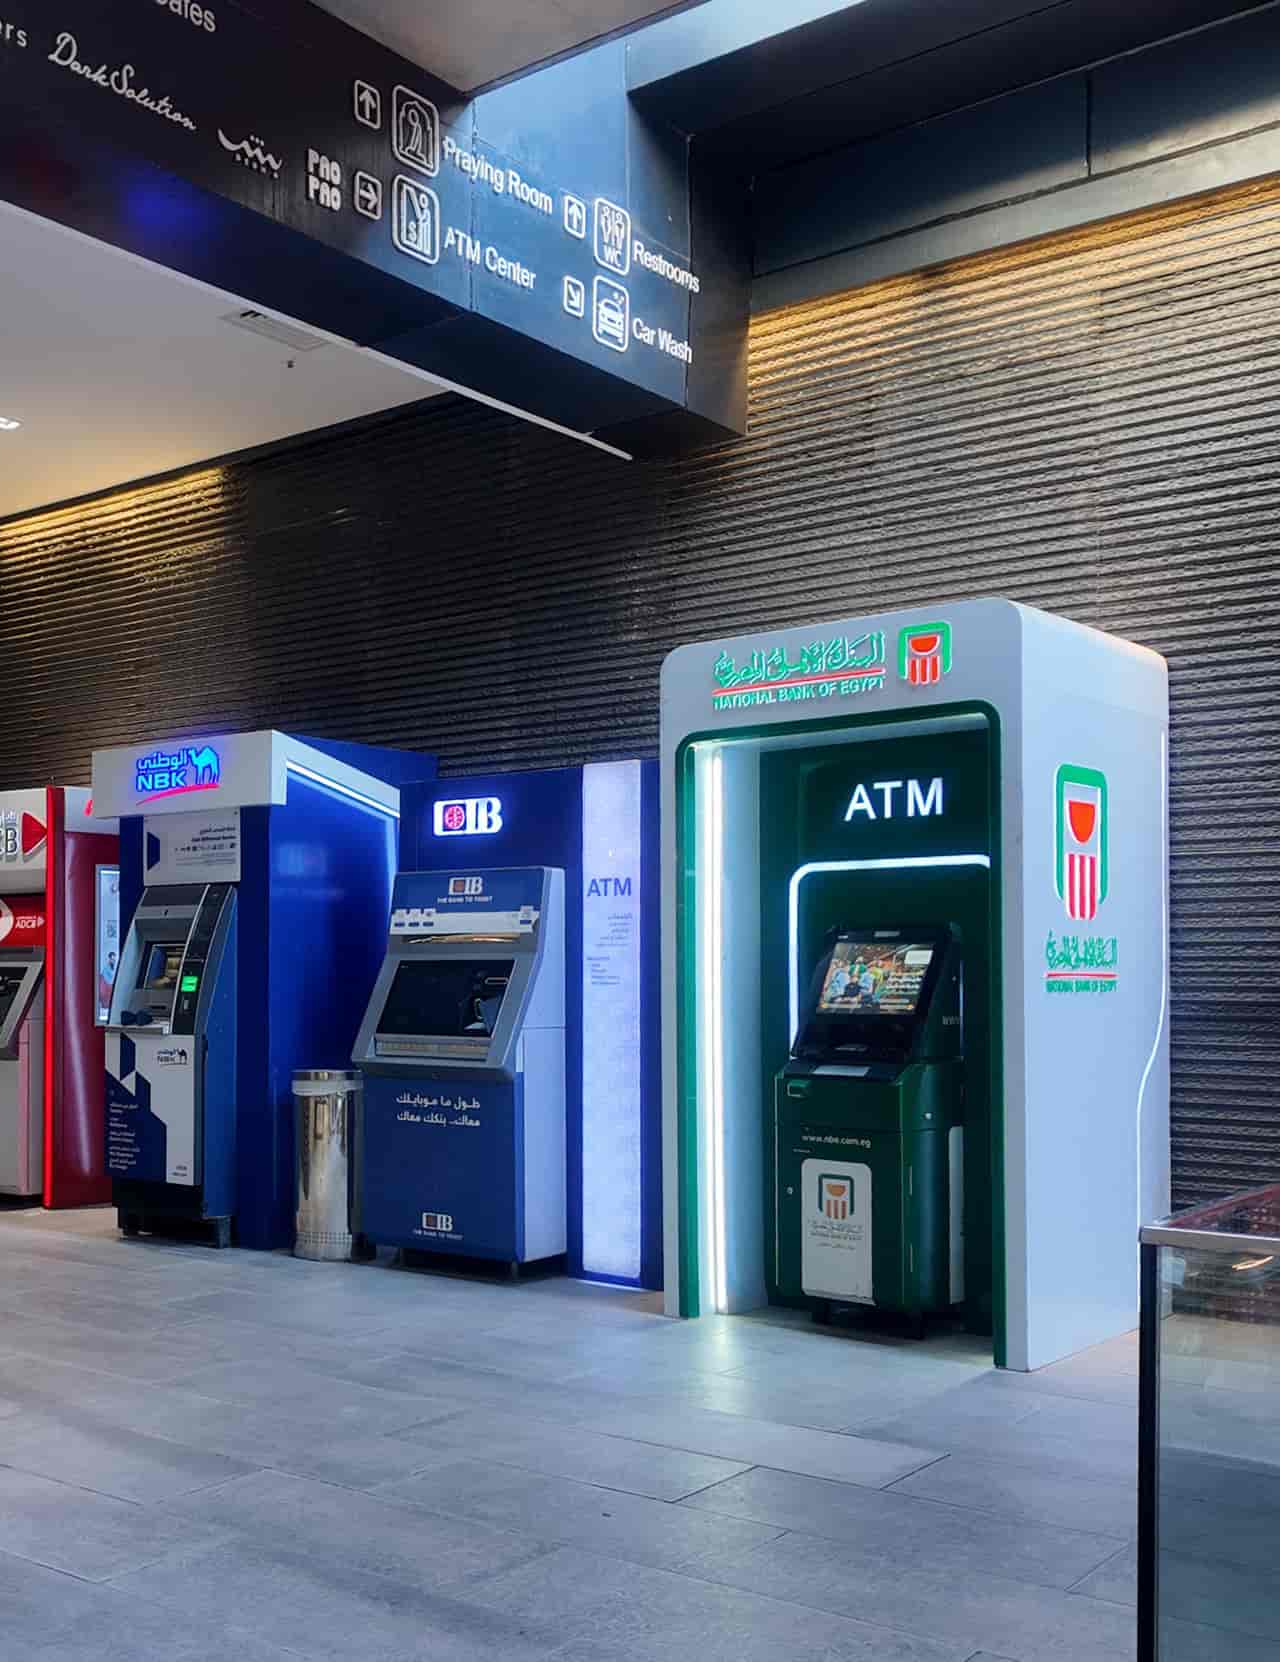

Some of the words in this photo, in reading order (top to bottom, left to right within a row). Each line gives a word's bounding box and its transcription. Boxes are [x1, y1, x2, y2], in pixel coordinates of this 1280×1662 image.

[442, 136, 504, 193] Praying
[507, 169, 553, 214] Room
[444, 227, 480, 264] ATM
[485, 247, 536, 289] Center
[633, 241, 700, 293] Restrooms
[632, 317, 656, 345] Car
[657, 328, 693, 363] Wash
[714, 689, 777, 710] NATIONAL
[778, 684, 816, 701] BANK
[819, 683, 838, 697] OF
[840, 676, 886, 694] EGYPT
[137, 770, 186, 791] NBK
[844, 776, 943, 822] ATM
[433, 797, 503, 836] CIB
[448, 876, 483, 896] CIB
[587, 877, 631, 896] ATM
[422, 1212, 453, 1232] CIB
